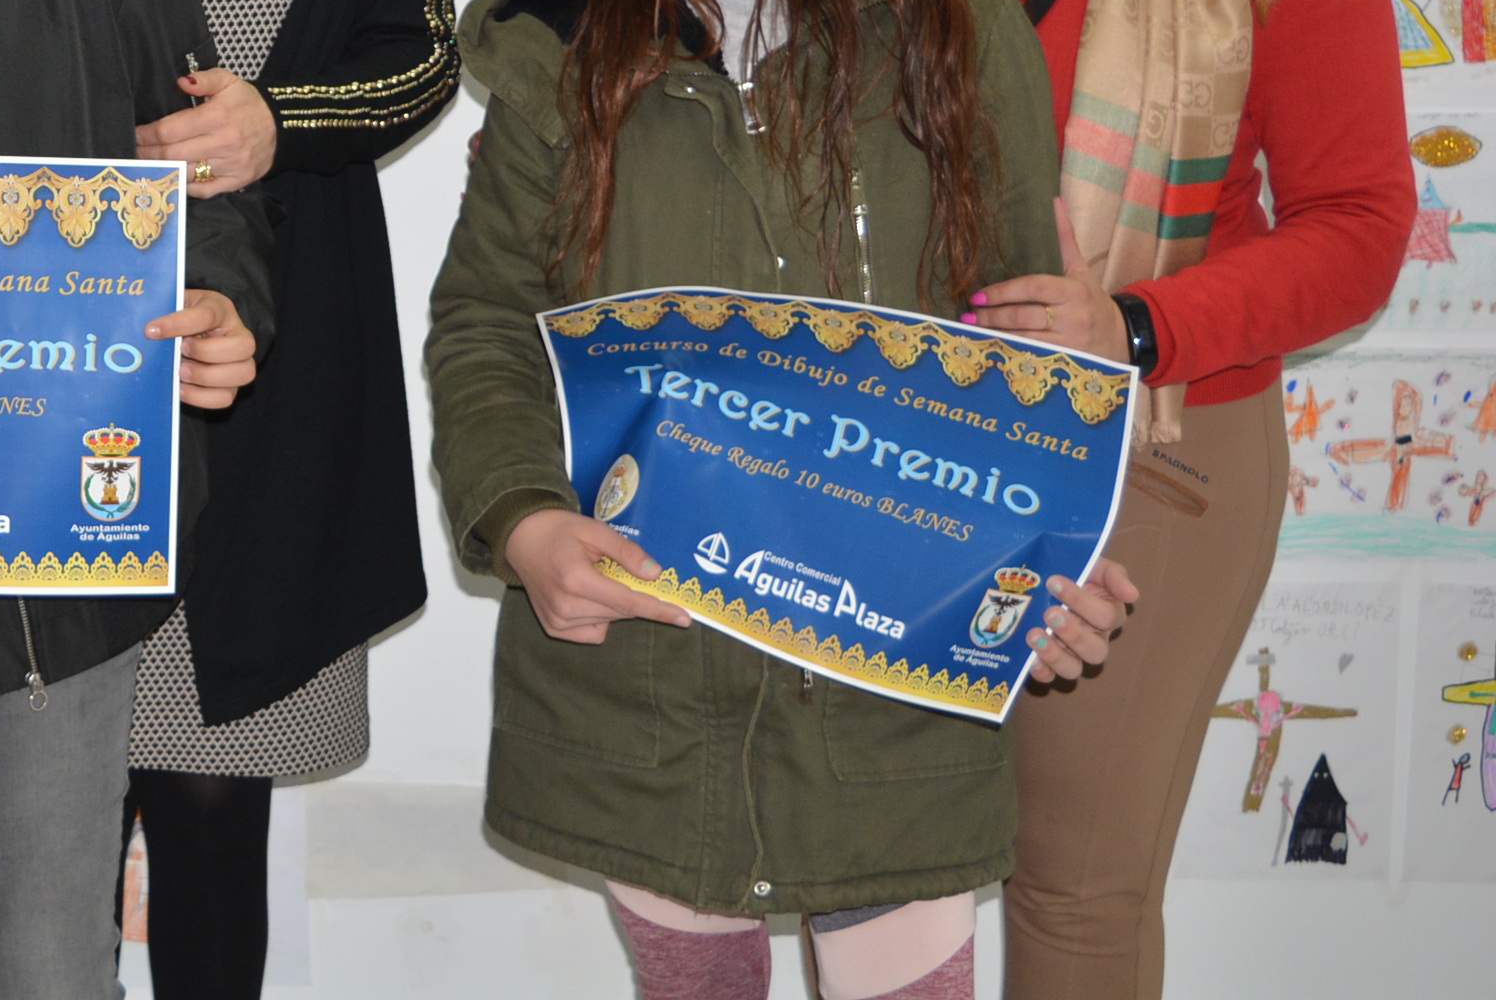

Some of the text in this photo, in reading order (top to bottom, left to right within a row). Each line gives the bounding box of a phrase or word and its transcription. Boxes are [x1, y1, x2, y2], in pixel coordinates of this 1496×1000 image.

[59, 271, 145, 296] Santa
[587, 340, 1089, 461] Concurso de Dibujo de Semana Santa
[624, 363, 1041, 516] Tercer Premio
[656, 420, 975, 542] Cheque Regalo 10 euros BLANES
[1152, 448, 1209, 484] SPAGNOLO
[70, 523, 150, 534] Ayuntamiento
[79, 532, 95, 541] de
[763, 551, 843, 587] Centro Comercial
[733, 549, 906, 640] Aguilas Plaza
[949, 644, 1011, 663] Ayuntamiento
[953, 653, 966, 662] de
